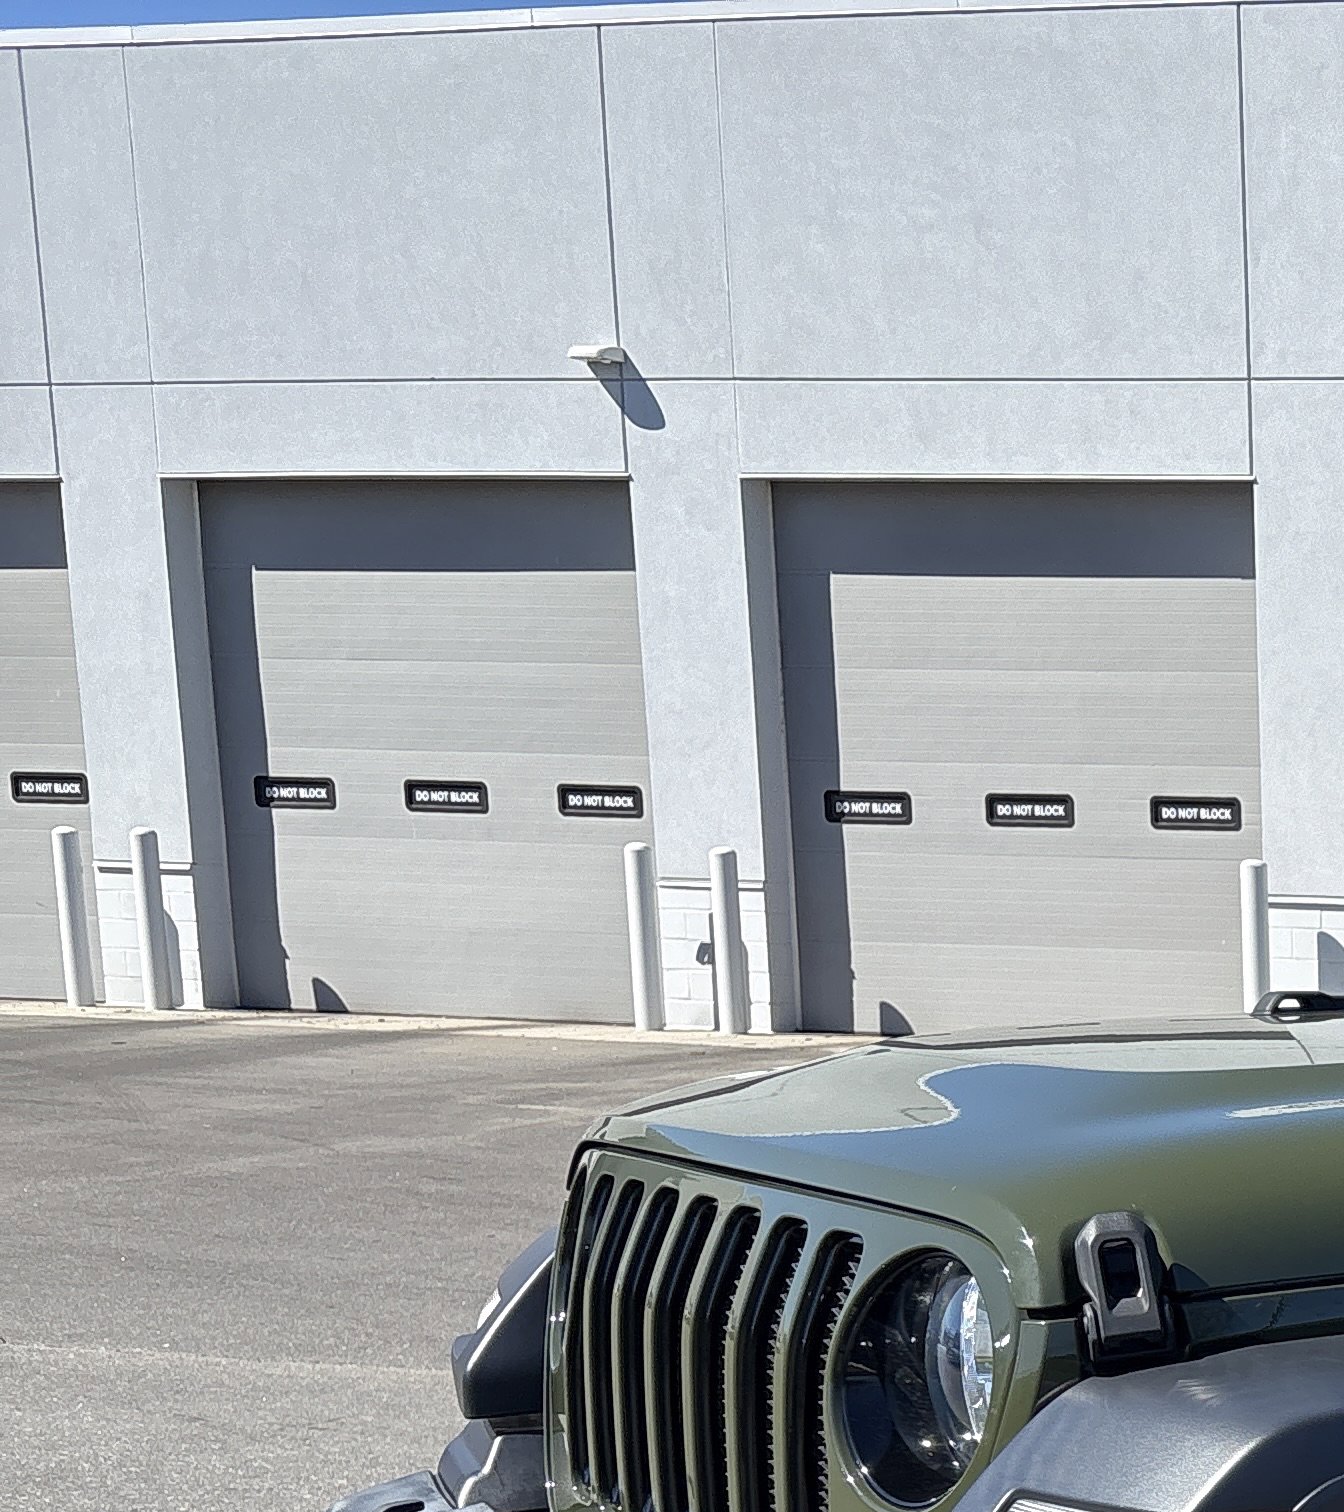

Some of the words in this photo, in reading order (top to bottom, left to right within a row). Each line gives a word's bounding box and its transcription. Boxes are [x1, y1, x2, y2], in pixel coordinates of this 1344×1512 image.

[21, 782, 34, 793] DO
[35, 782, 53, 793] NOT
[54, 783, 81, 794] BLOCK
[265, 787, 279, 798] DO
[280, 787, 297, 798] NOT
[299, 787, 327, 799] BLOCK
[415, 790, 429, 801] DO
[430, 790, 449, 802] NOT
[450, 791, 479, 803] BLOCK
[568, 795, 582, 806] DO
[584, 795, 602, 807] NOT
[604, 795, 634, 807] BLOCK
[836, 801, 849, 813] DO
[851, 802, 870, 813] NOT
[872, 802, 902, 814] BLOCK
[997, 804, 1011, 816] DO
[1013, 804, 1033, 816] NOT
[1034, 804, 1065, 816] BLOCK
[1162, 807, 1176, 819] DO
[1178, 807, 1198, 819] NOT
[1200, 808, 1232, 820] BLOCK
